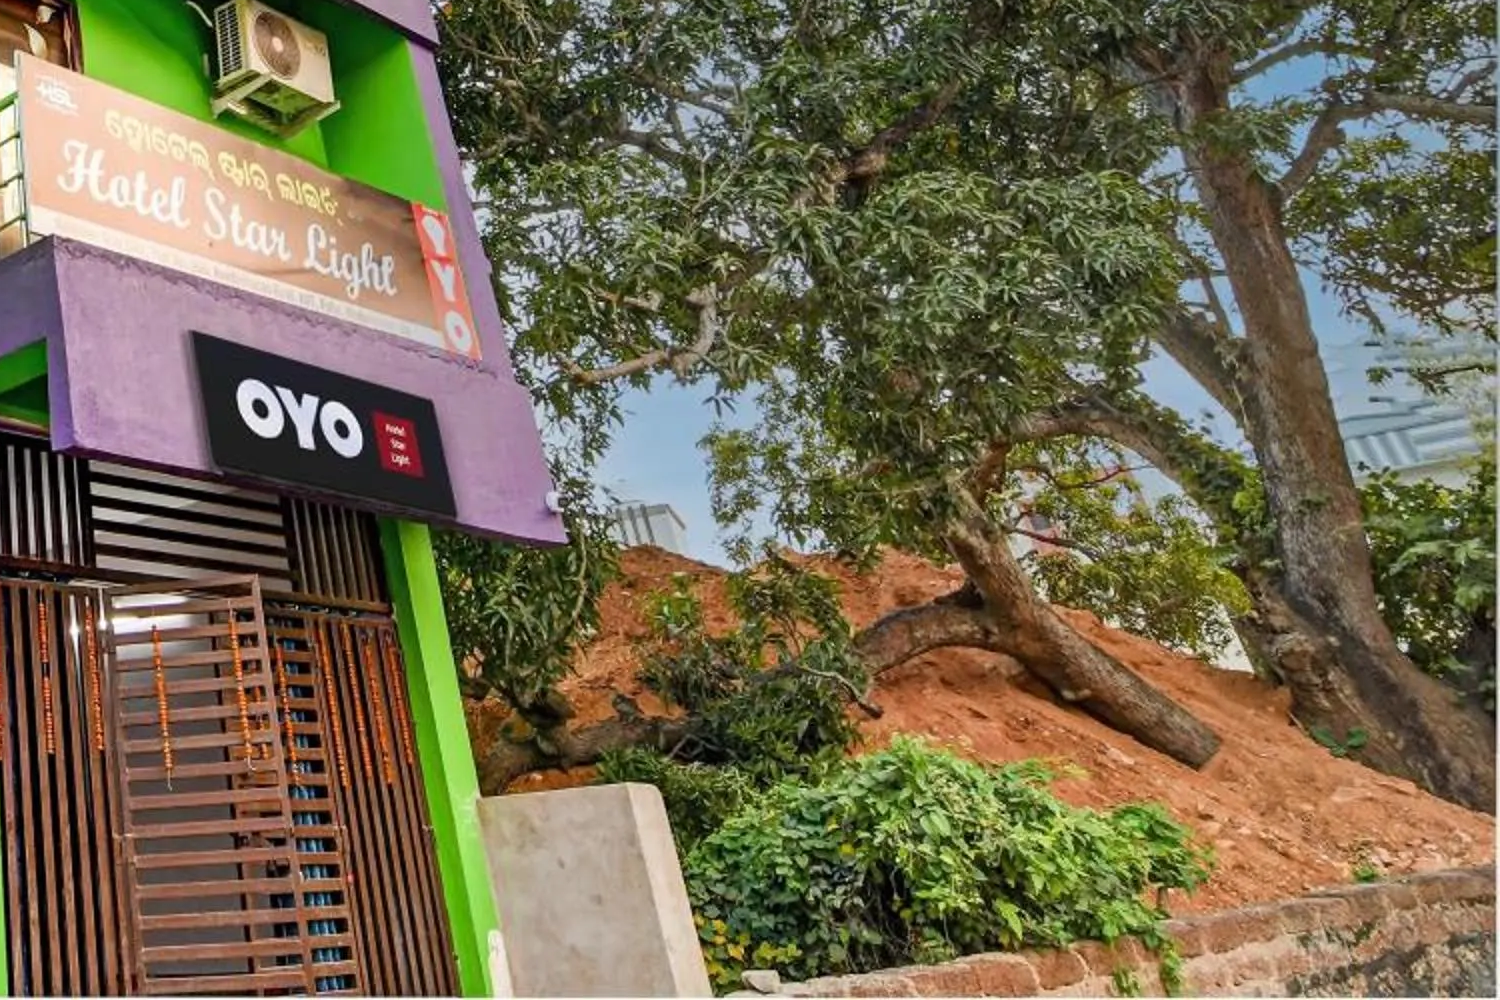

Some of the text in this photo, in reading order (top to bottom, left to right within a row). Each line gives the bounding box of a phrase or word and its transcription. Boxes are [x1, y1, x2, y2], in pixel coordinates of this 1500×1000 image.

[56, 139, 191, 228] Hotel
[203, 186, 292, 261] Star
[303, 222, 397, 300] Light
[236, 378, 364, 459] OYO
